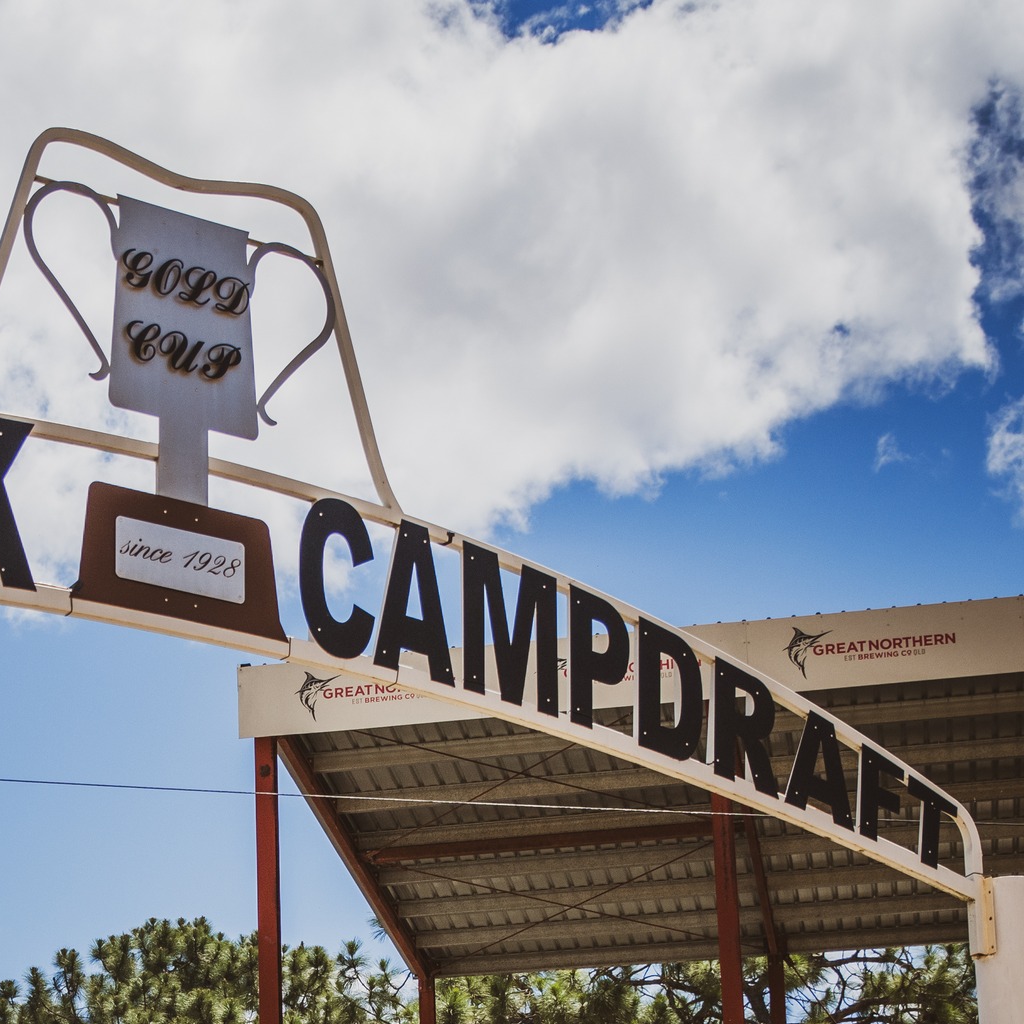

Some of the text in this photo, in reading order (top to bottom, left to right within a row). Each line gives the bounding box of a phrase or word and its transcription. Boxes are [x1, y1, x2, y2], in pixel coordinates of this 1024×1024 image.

[122, 248, 250, 315] GOLD
[126, 320, 242, 380] CUP
[119, 538, 242, 578] since 1928
[813, 633, 956, 656] GREAT NORTHERN
[844, 654, 856, 662] EST
[858, 650, 899, 660] BREWING
[300, 498, 958, 869] CAMPDRAFT
[365, 694, 403, 703] BREWING
